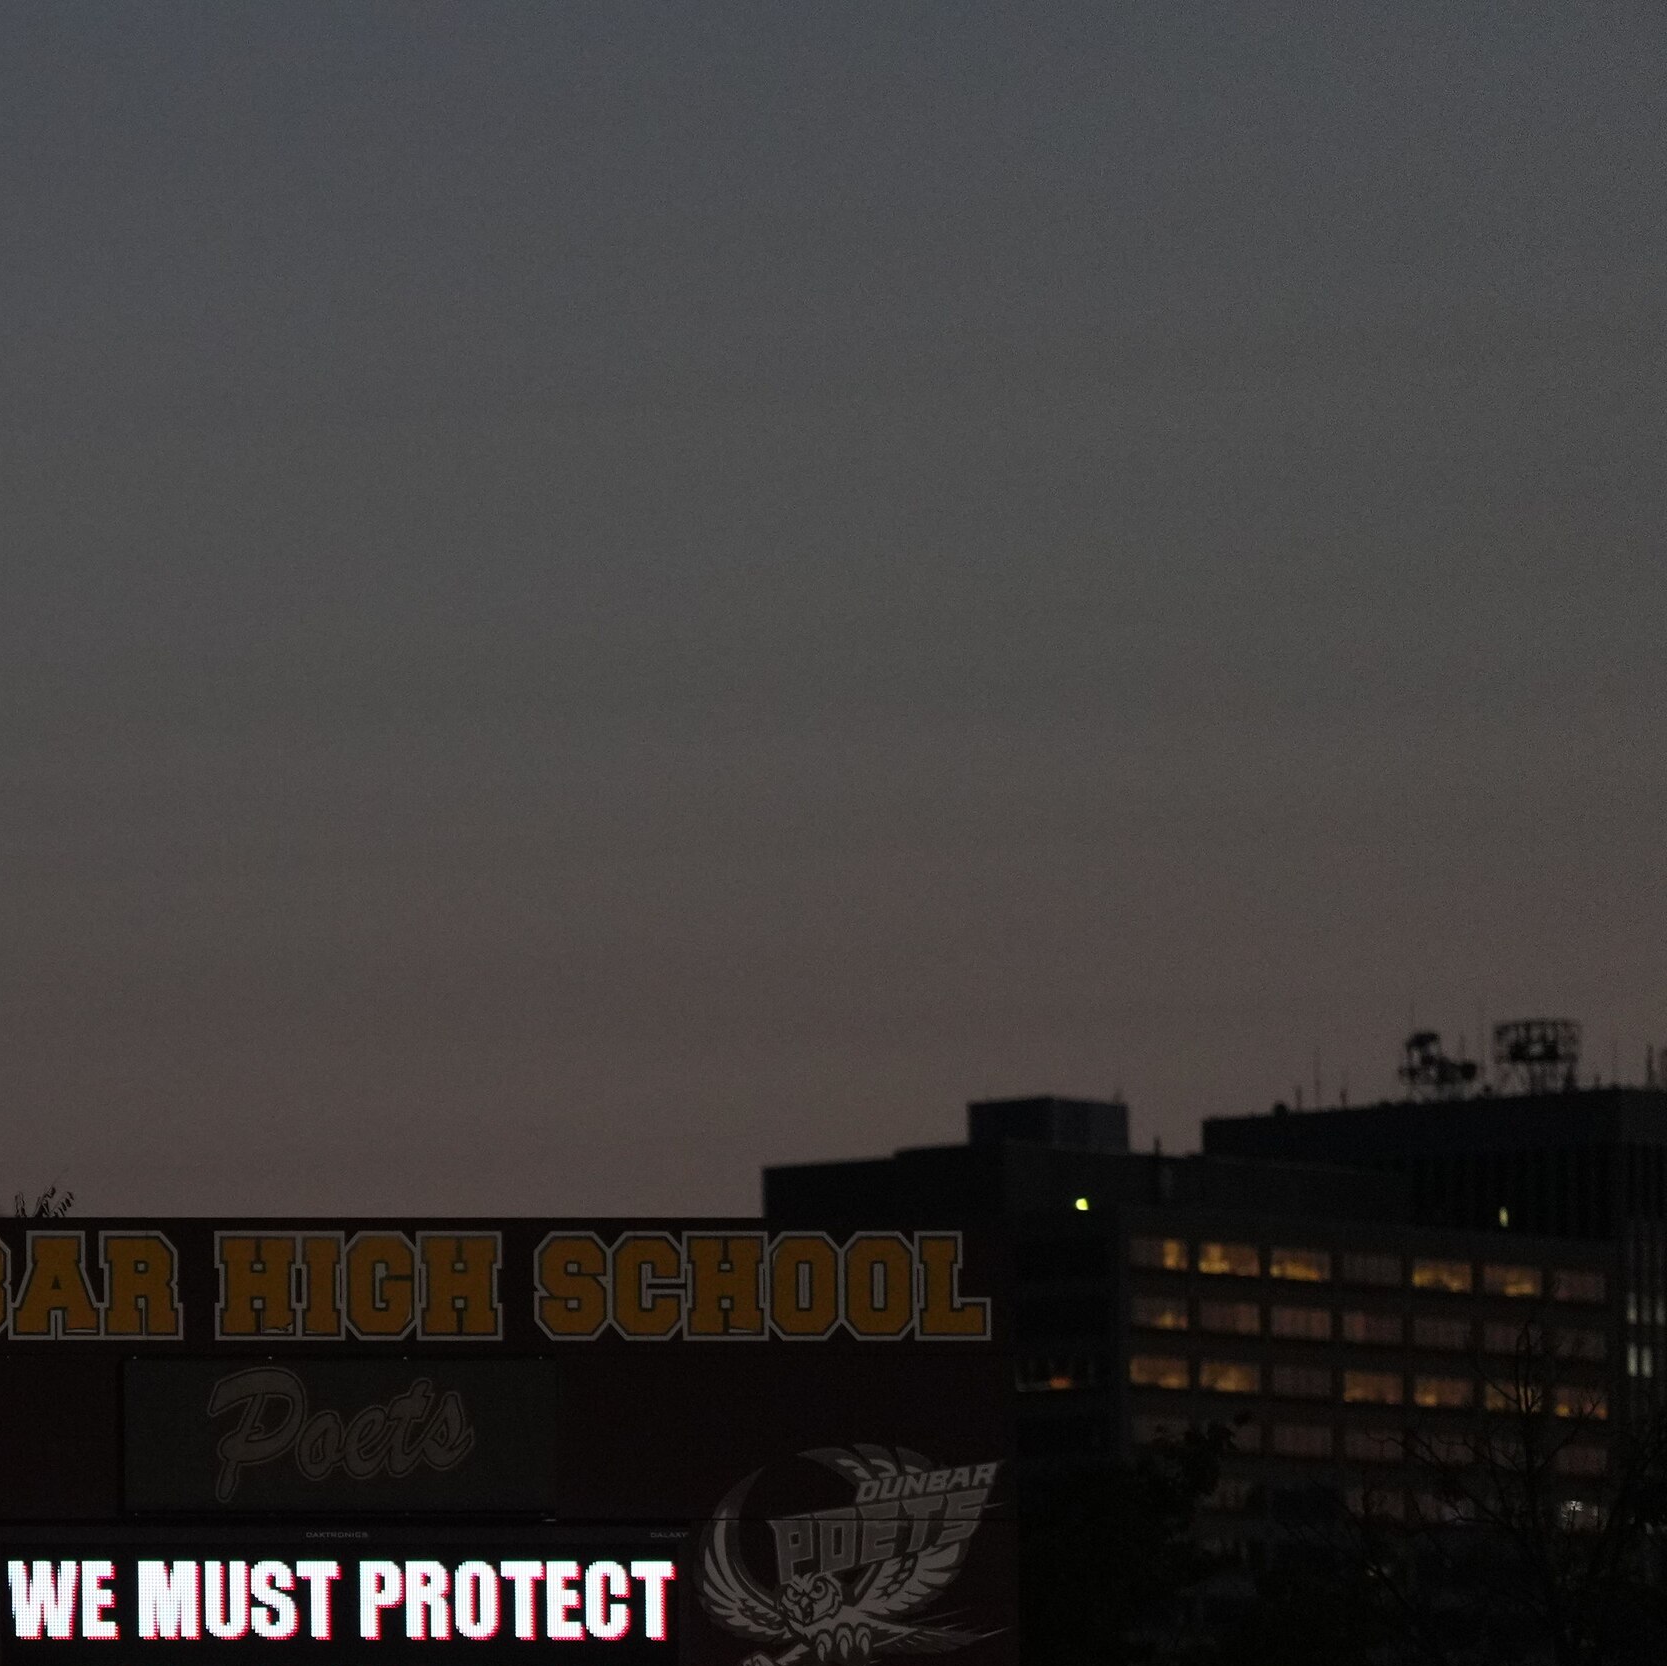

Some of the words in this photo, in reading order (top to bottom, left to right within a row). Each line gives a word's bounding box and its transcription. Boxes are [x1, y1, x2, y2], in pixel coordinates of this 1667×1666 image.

[214, 1230, 503, 1341] HIGH
[533, 1230, 992, 1342] SCHOOL
[208, 1366, 475, 1503] Poets
[856, 1461, 998, 1503] DUNBAR
[766, 1487, 988, 1585] POETS
[7, 1561, 120, 1640] WE
[137, 1561, 342, 1640] MUST
[359, 1561, 677, 1640] PROTECT
